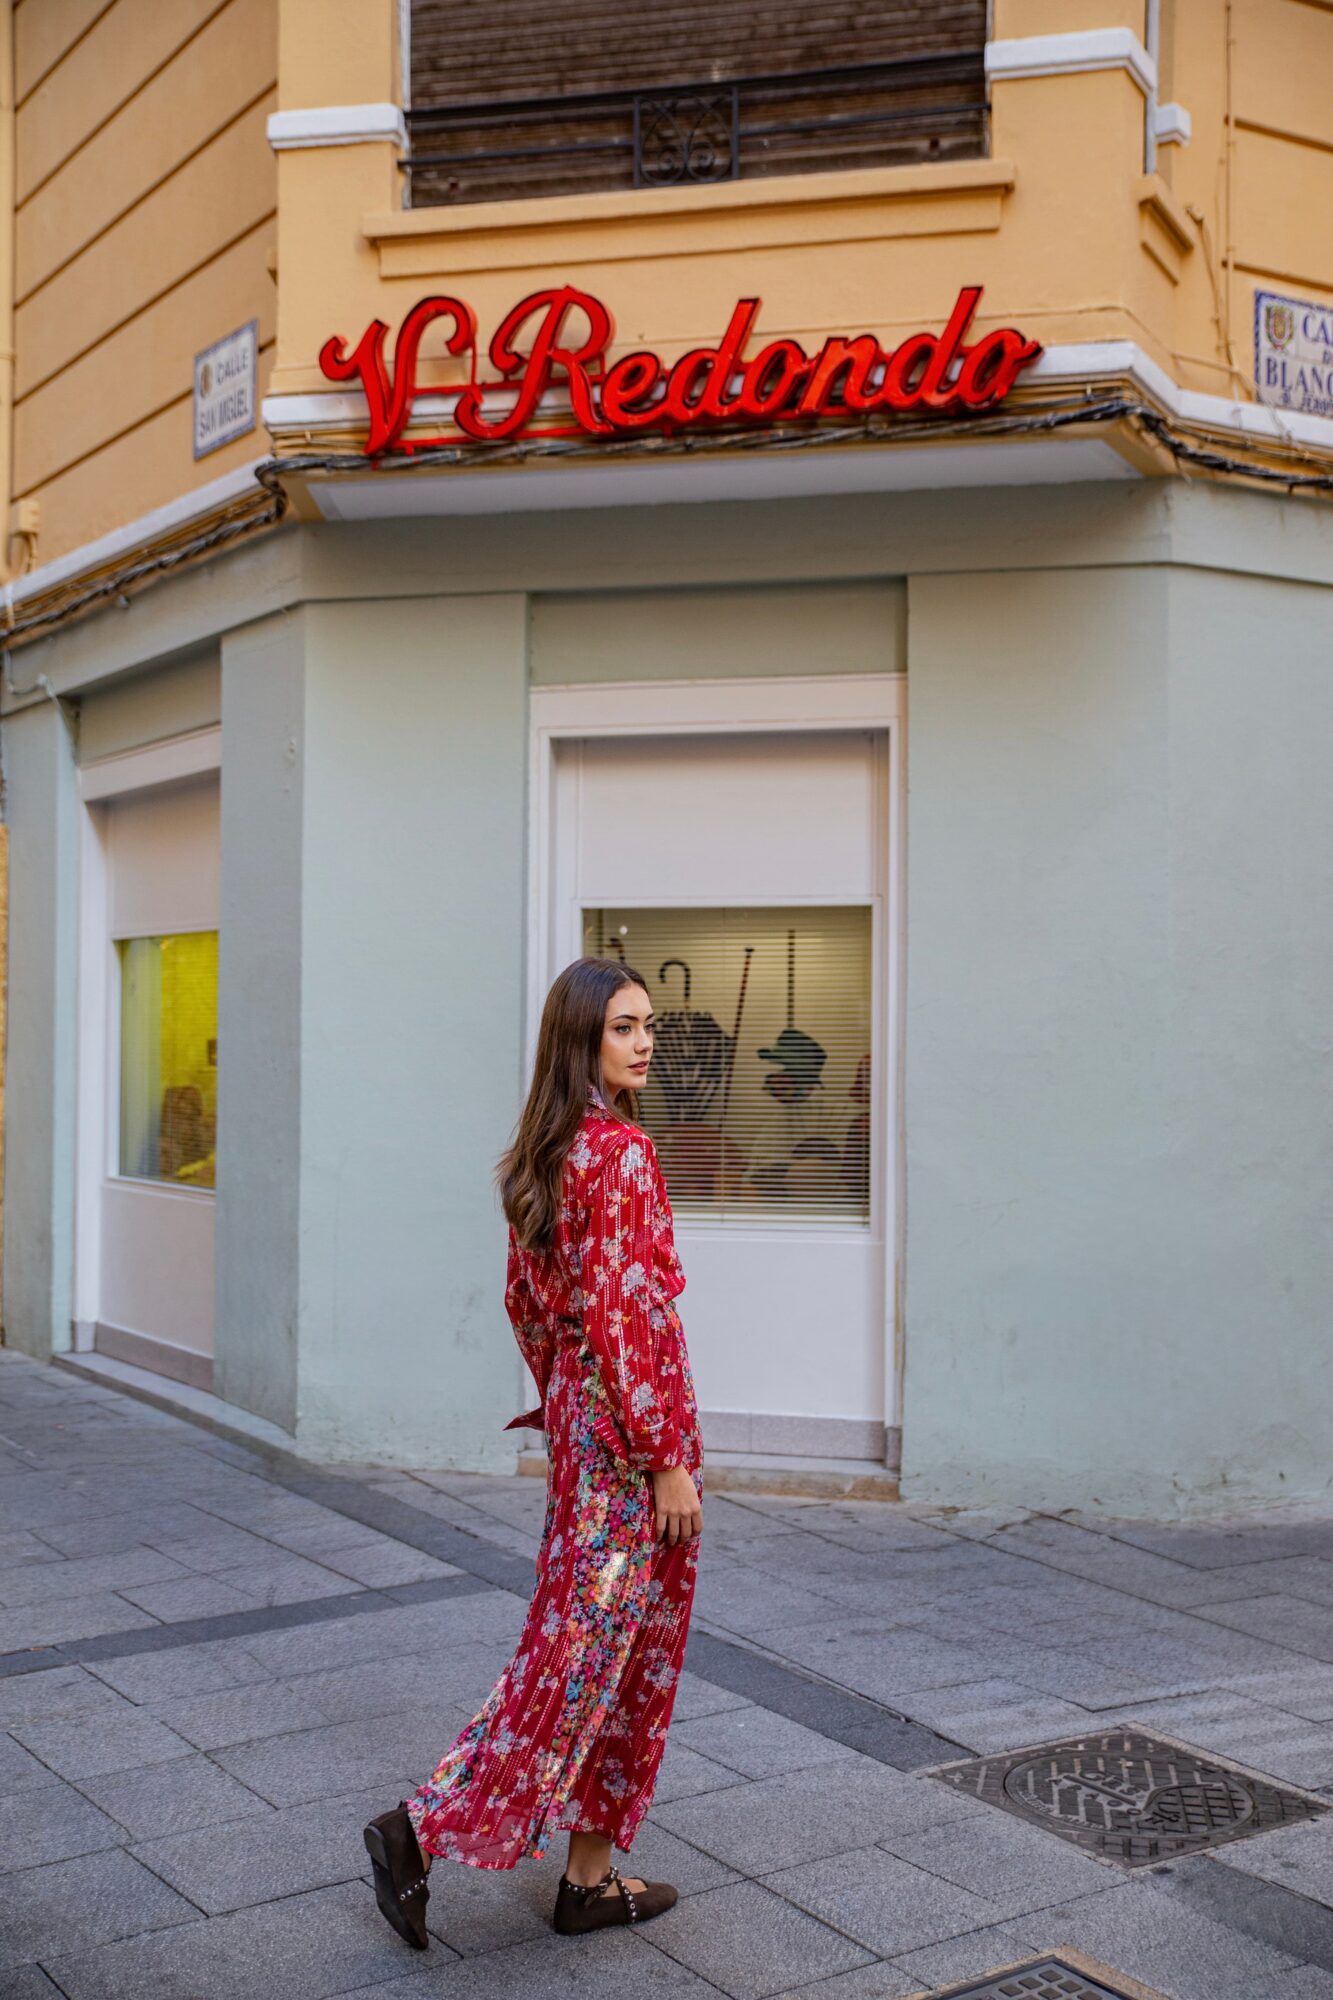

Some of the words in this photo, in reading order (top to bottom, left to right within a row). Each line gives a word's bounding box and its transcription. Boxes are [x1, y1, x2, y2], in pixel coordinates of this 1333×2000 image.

[217, 347, 249, 384] CALLE
[319, 296, 478, 455] V
[454, 284, 1044, 440] Redondo
[200, 406, 217, 438] SAN
[219, 388, 249, 425] MIGUEL
